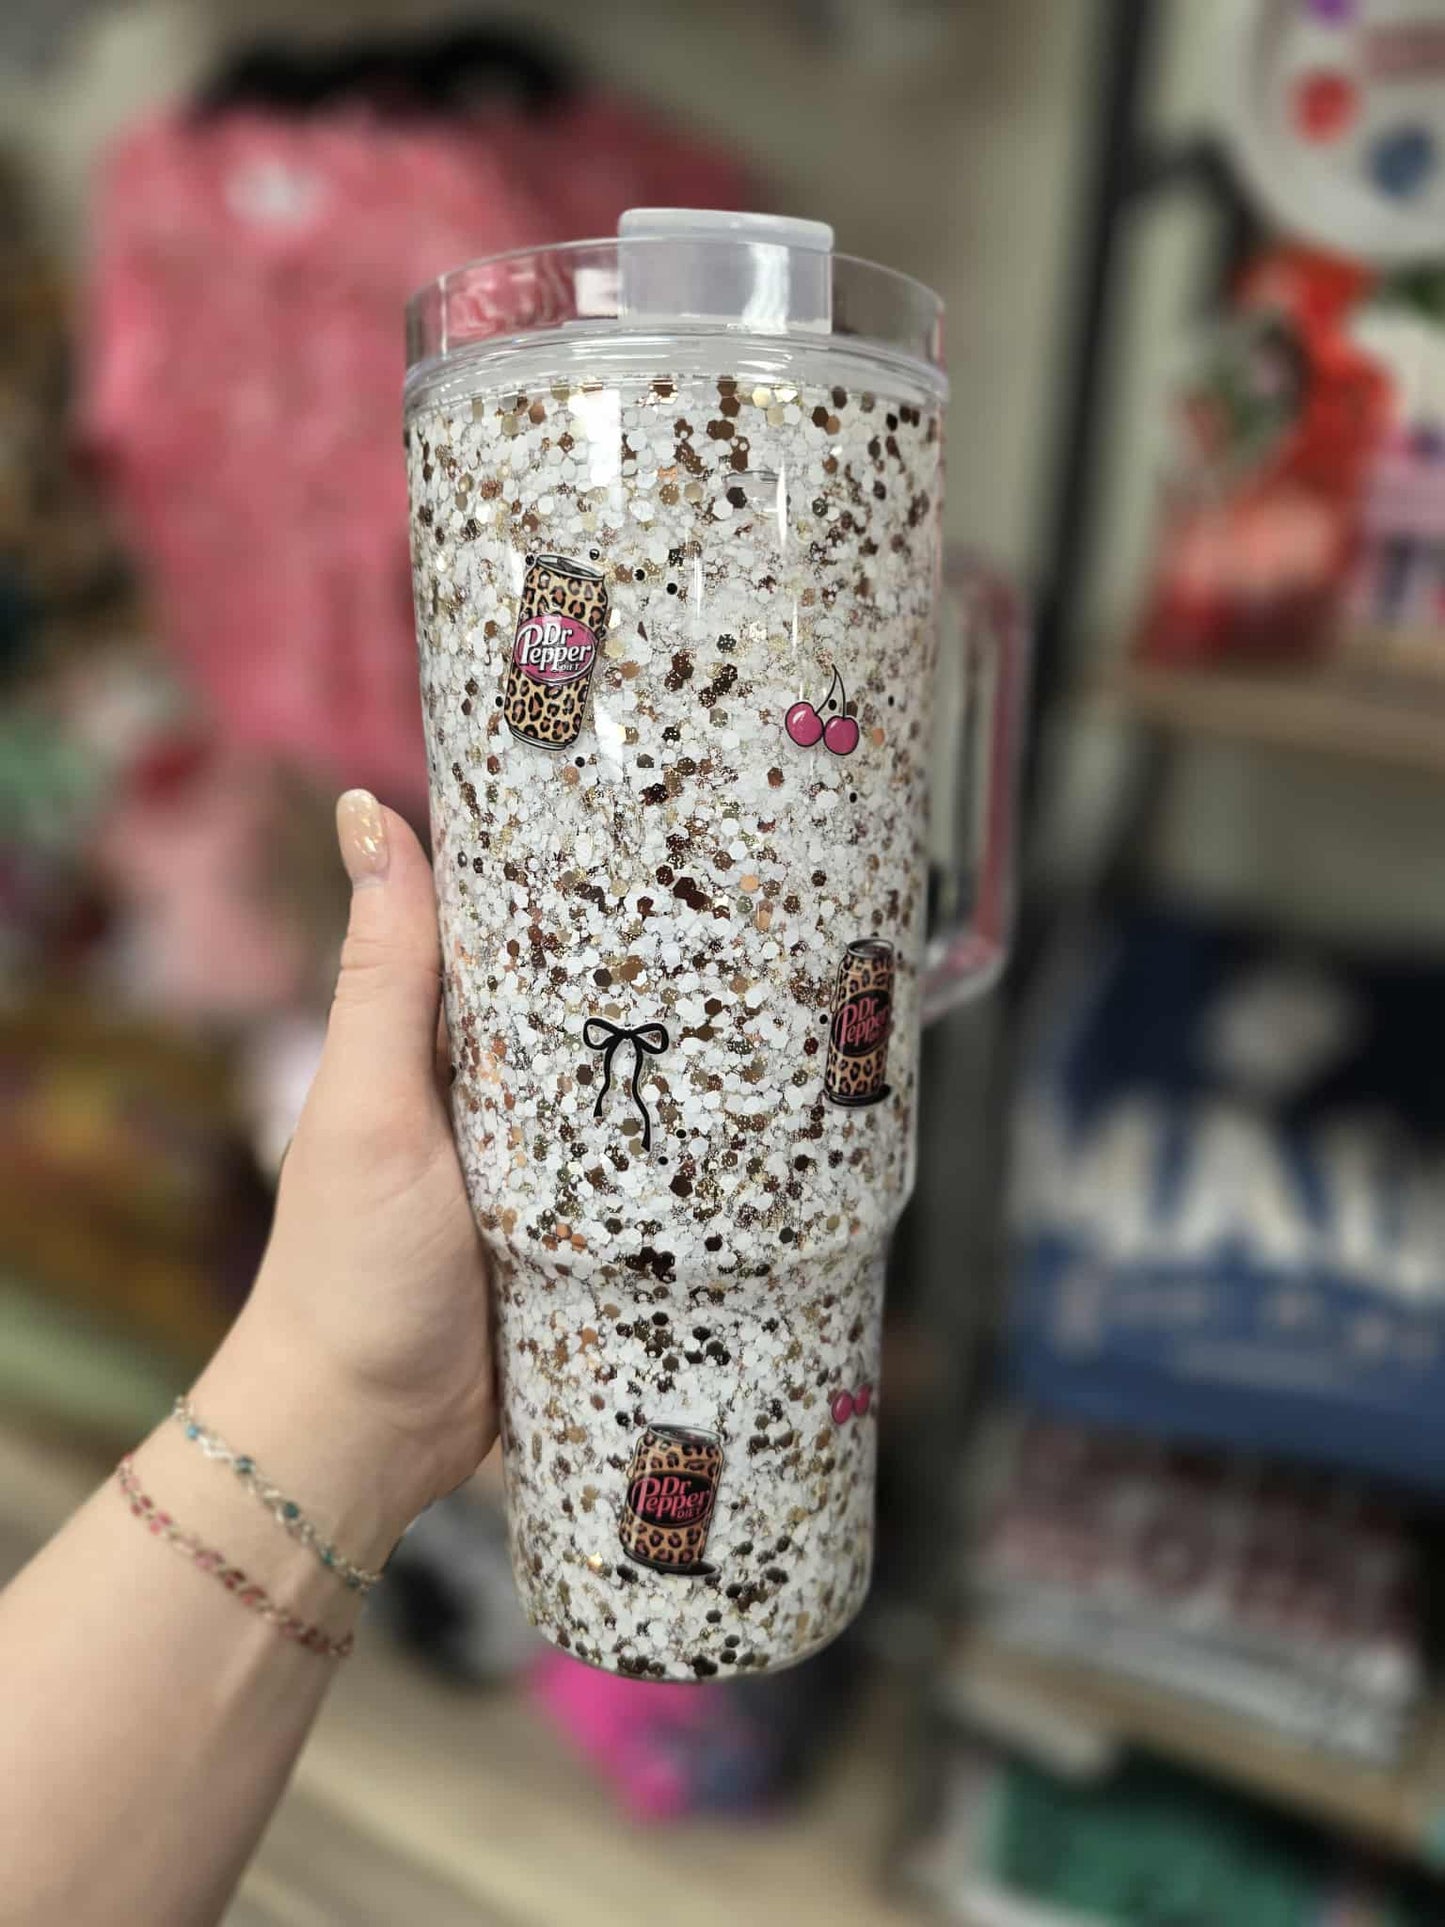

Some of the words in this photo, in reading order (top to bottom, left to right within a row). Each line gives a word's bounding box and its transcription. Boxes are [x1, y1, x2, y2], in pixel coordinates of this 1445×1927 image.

[543, 621, 574, 646] Dr
[517, 624, 592, 672] Pepper
[858, 996, 879, 1021] Dr
[837, 1003, 889, 1048] Pepper
[634, 1477, 710, 1520] Pepper
[661, 1476, 692, 1496] Dr
[677, 1506, 701, 1519] DIET
